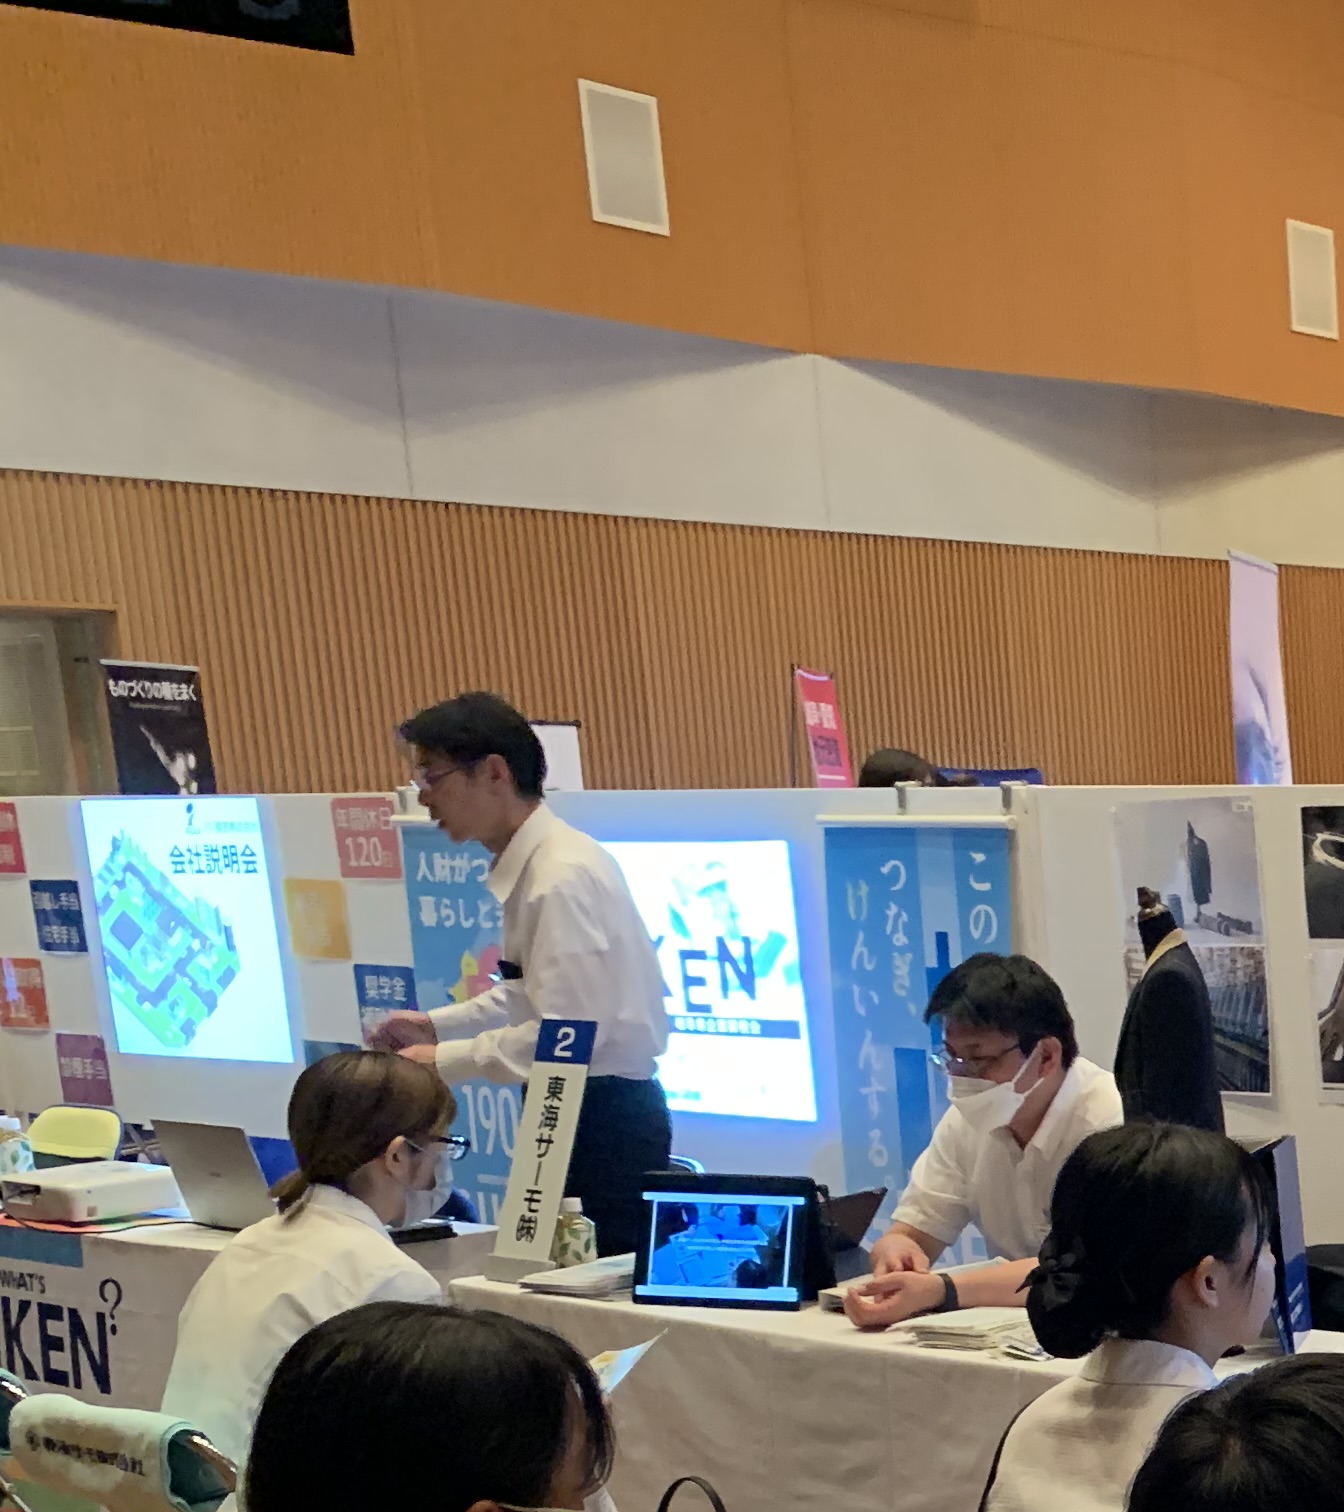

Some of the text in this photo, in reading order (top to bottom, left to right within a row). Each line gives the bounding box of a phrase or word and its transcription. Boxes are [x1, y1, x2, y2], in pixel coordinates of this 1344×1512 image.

[169, 845, 258, 874] 会社説明会
[968, 850, 999, 945] この
[654, 935, 757, 1014] EN
[553, 1026, 577, 1058] 2
